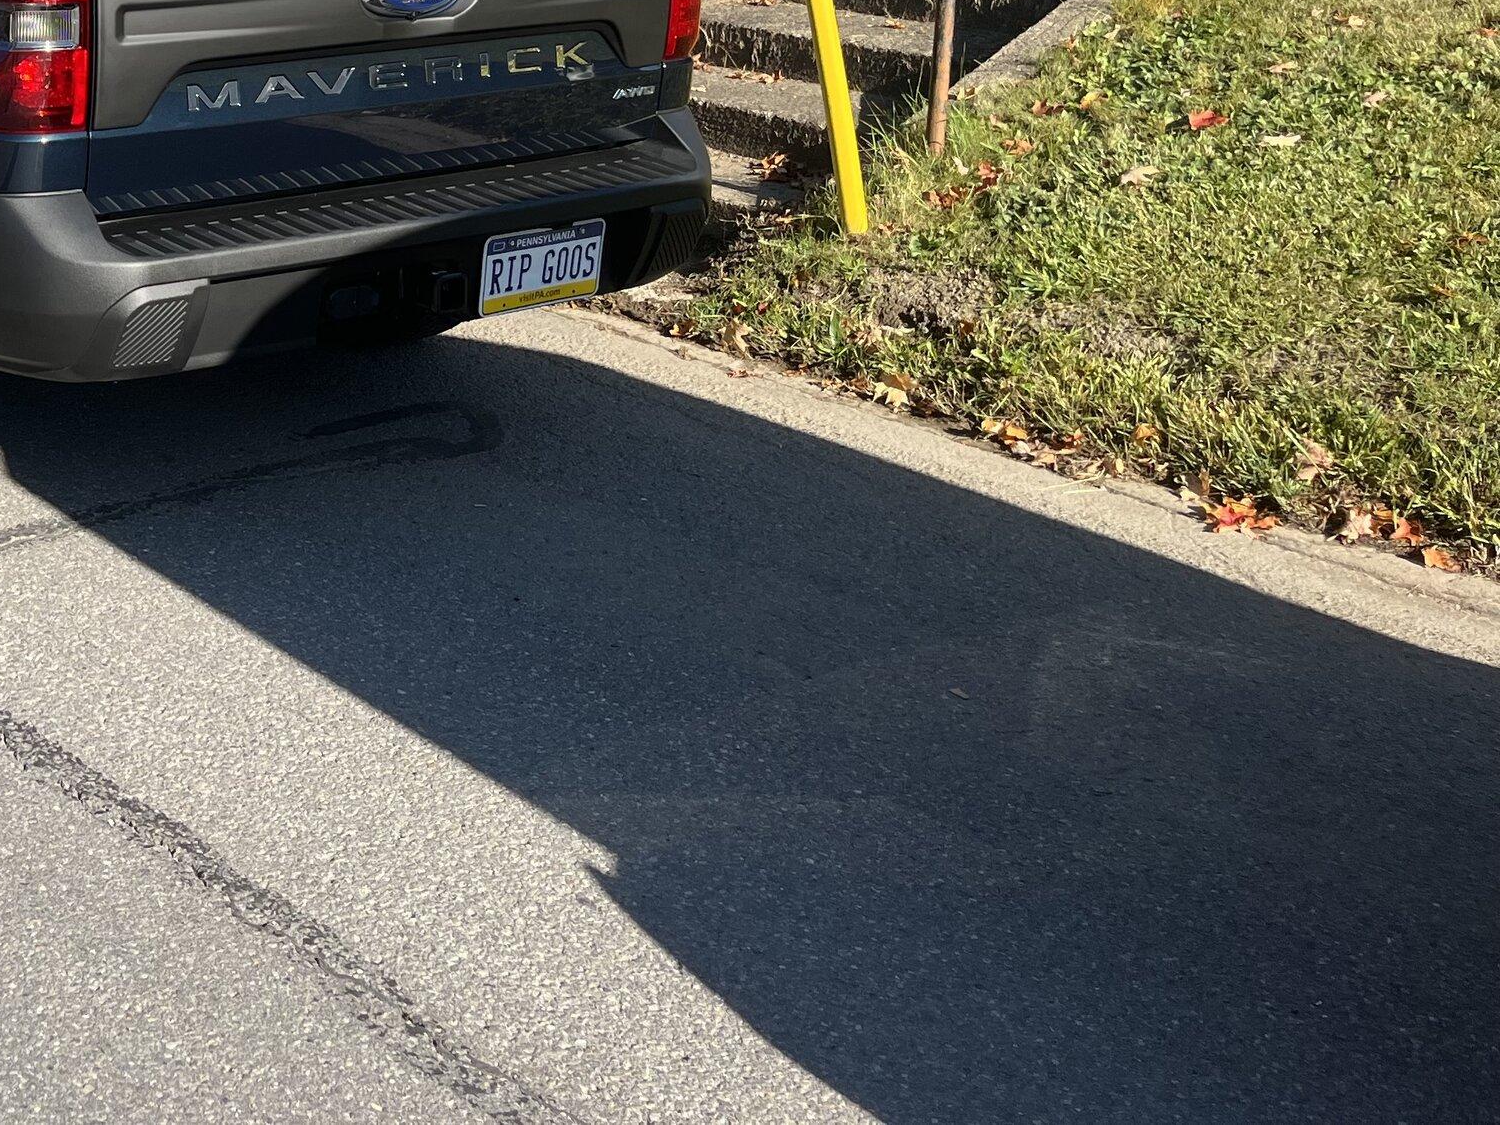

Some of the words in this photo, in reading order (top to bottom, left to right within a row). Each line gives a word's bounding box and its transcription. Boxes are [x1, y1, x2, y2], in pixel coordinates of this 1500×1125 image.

[185, 41, 590, 111] MAVERICK
[516, 229, 577, 248] PENNSYLVANIA
[489, 253, 532, 295] RIP
[519, 288, 561, 303] visitPA.com
